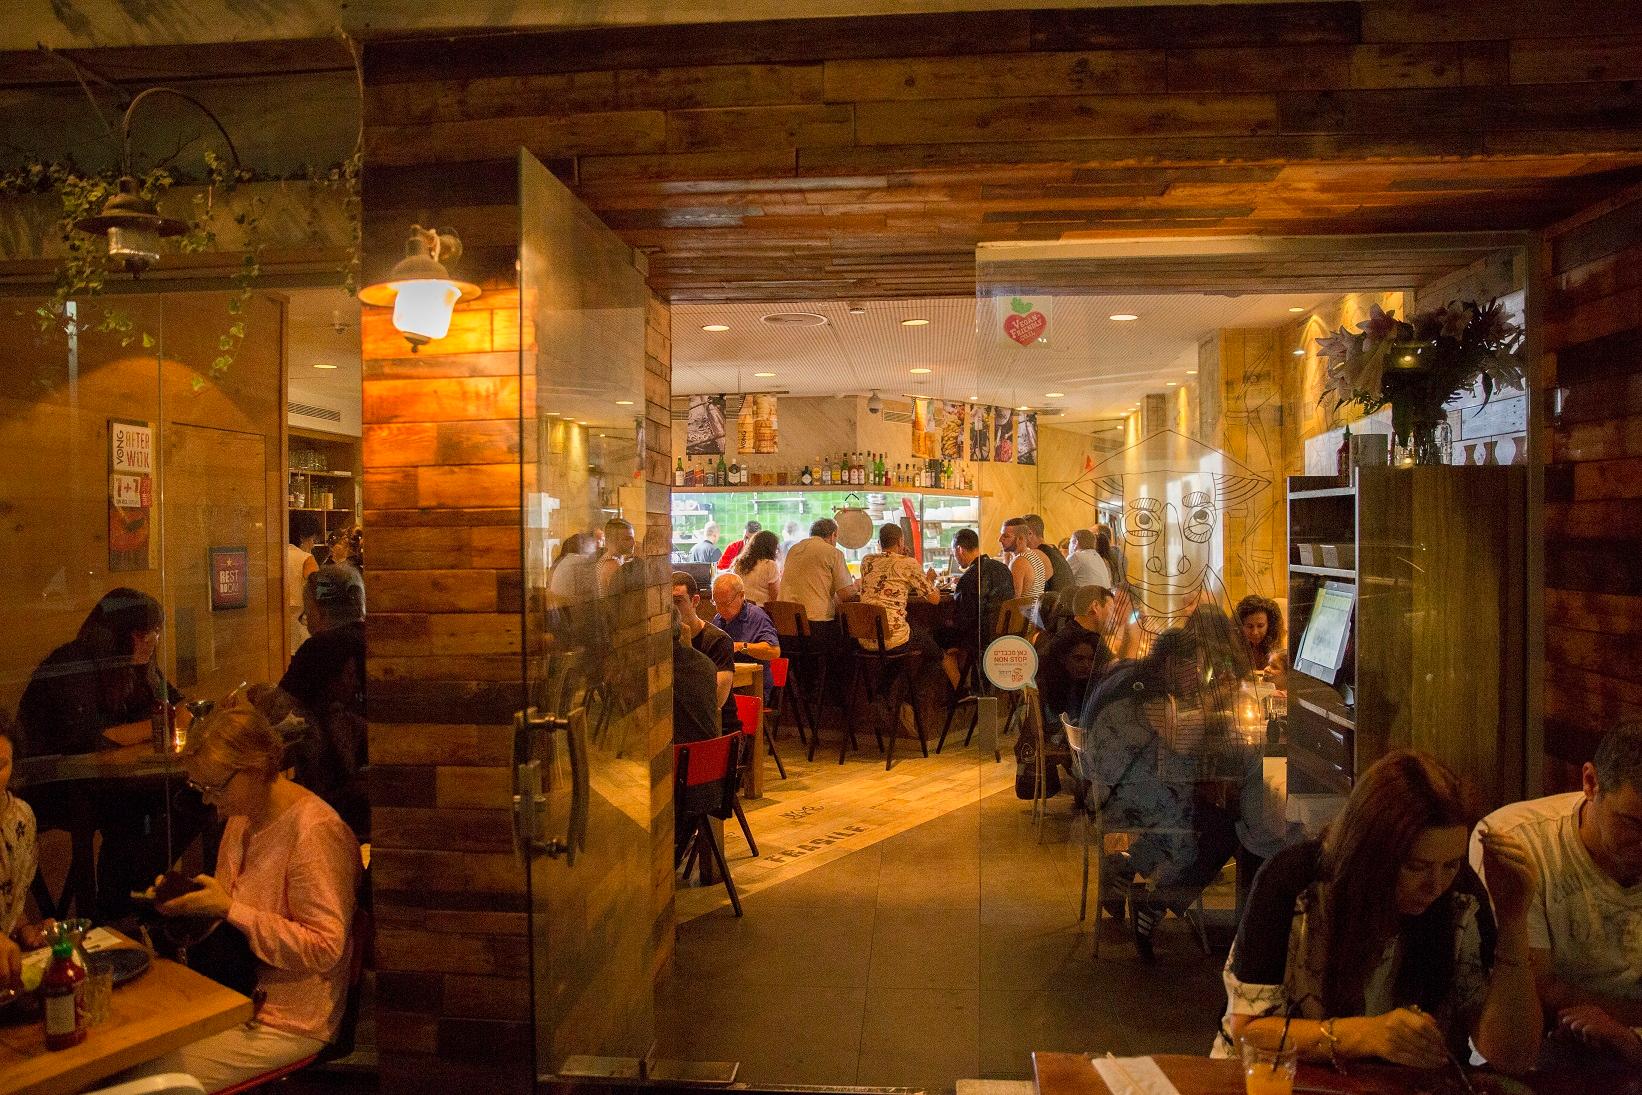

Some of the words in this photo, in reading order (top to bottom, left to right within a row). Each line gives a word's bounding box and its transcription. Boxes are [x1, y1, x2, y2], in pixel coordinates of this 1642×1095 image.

[1010, 319, 1042, 338] FRIENDLY
[125, 431, 150, 449] AFTER
[126, 450, 150, 468] WOK
[764, 824, 867, 863] FRAGILE
